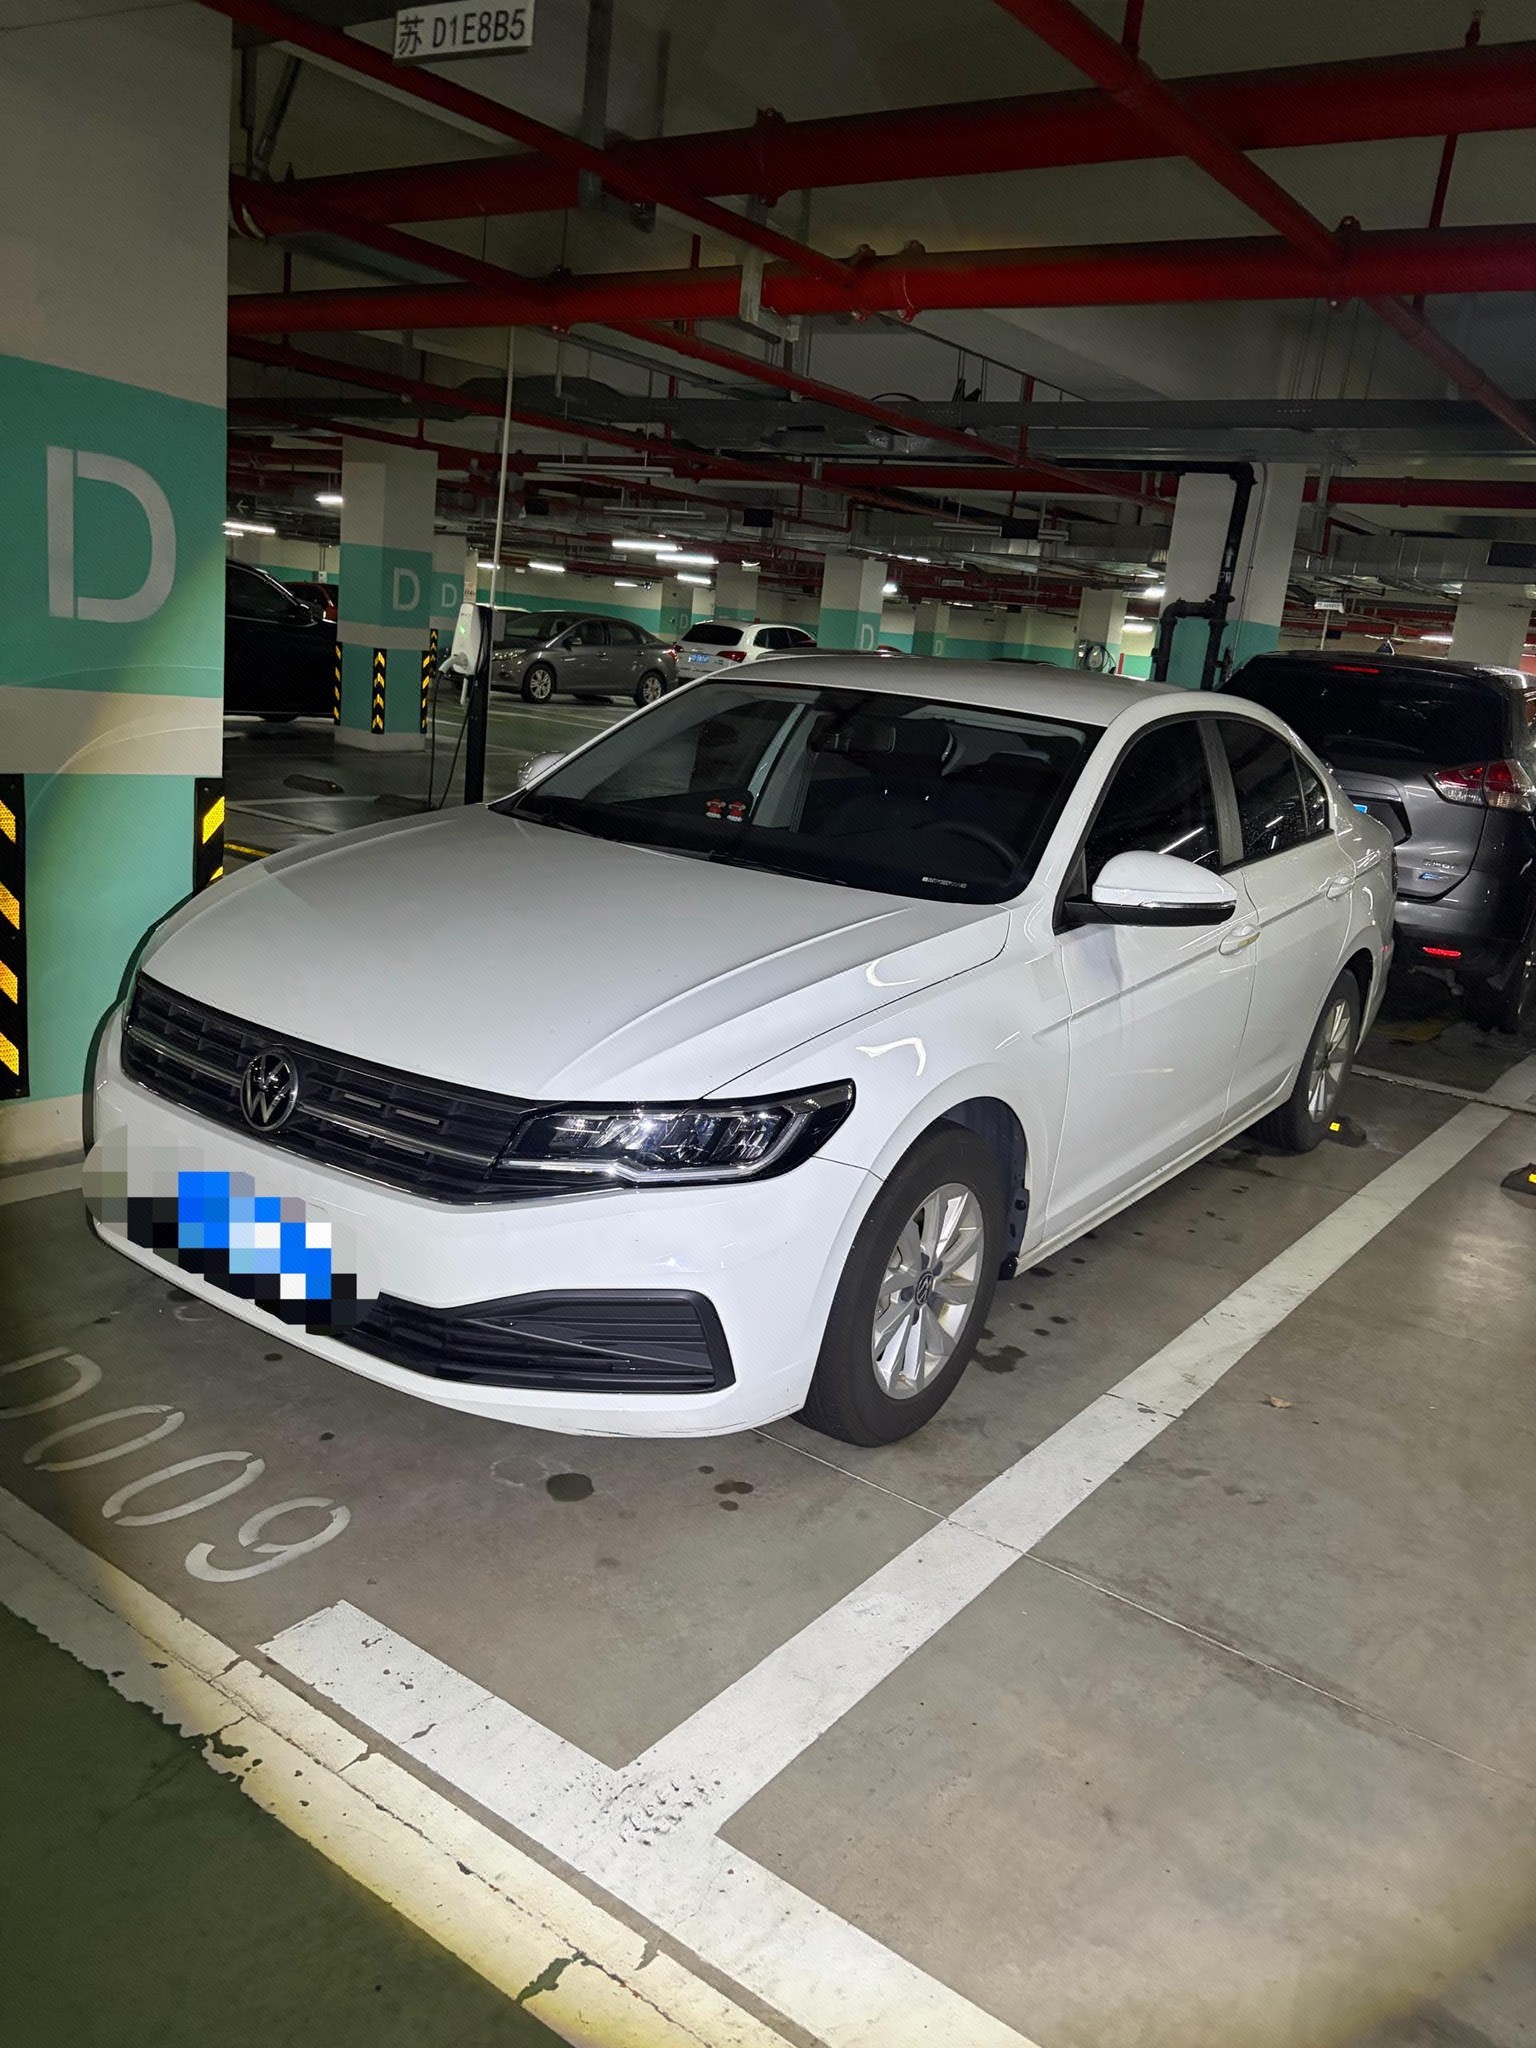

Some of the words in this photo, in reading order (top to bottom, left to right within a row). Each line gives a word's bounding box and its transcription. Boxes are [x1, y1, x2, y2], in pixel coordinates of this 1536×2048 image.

[399, 15, 425, 55] 苏
[433, 9, 526, 48] D1E8B5
[46, 445, 177, 624] D
[393, 567, 420, 612] D
[441, 583, 457, 608] D
[861, 623, 874, 650] D
